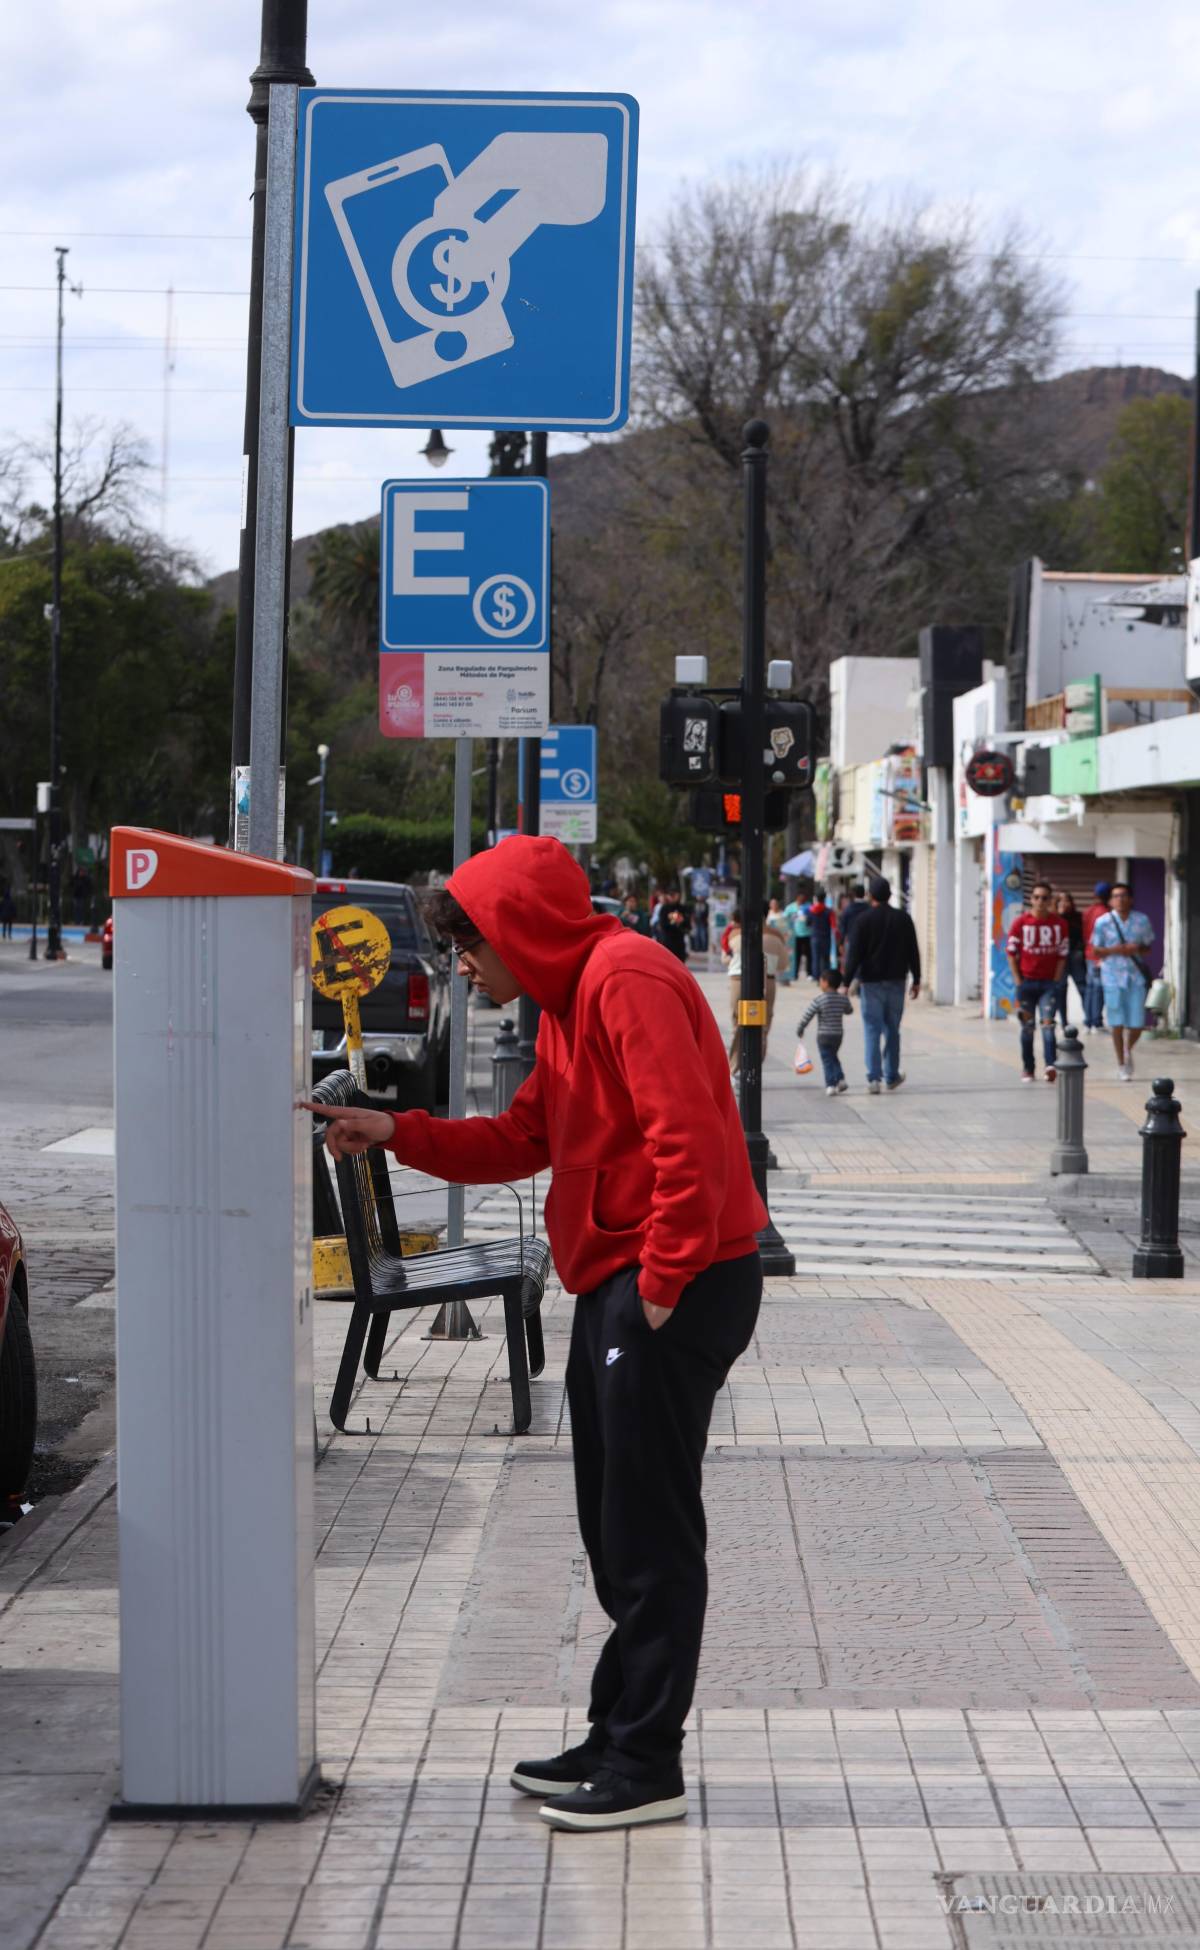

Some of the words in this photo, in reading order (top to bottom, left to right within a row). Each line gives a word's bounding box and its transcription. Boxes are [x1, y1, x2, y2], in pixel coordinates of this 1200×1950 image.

[392, 491, 470, 596] E
[498, 672, 516, 680] Pago
[131, 853, 150, 884] P
